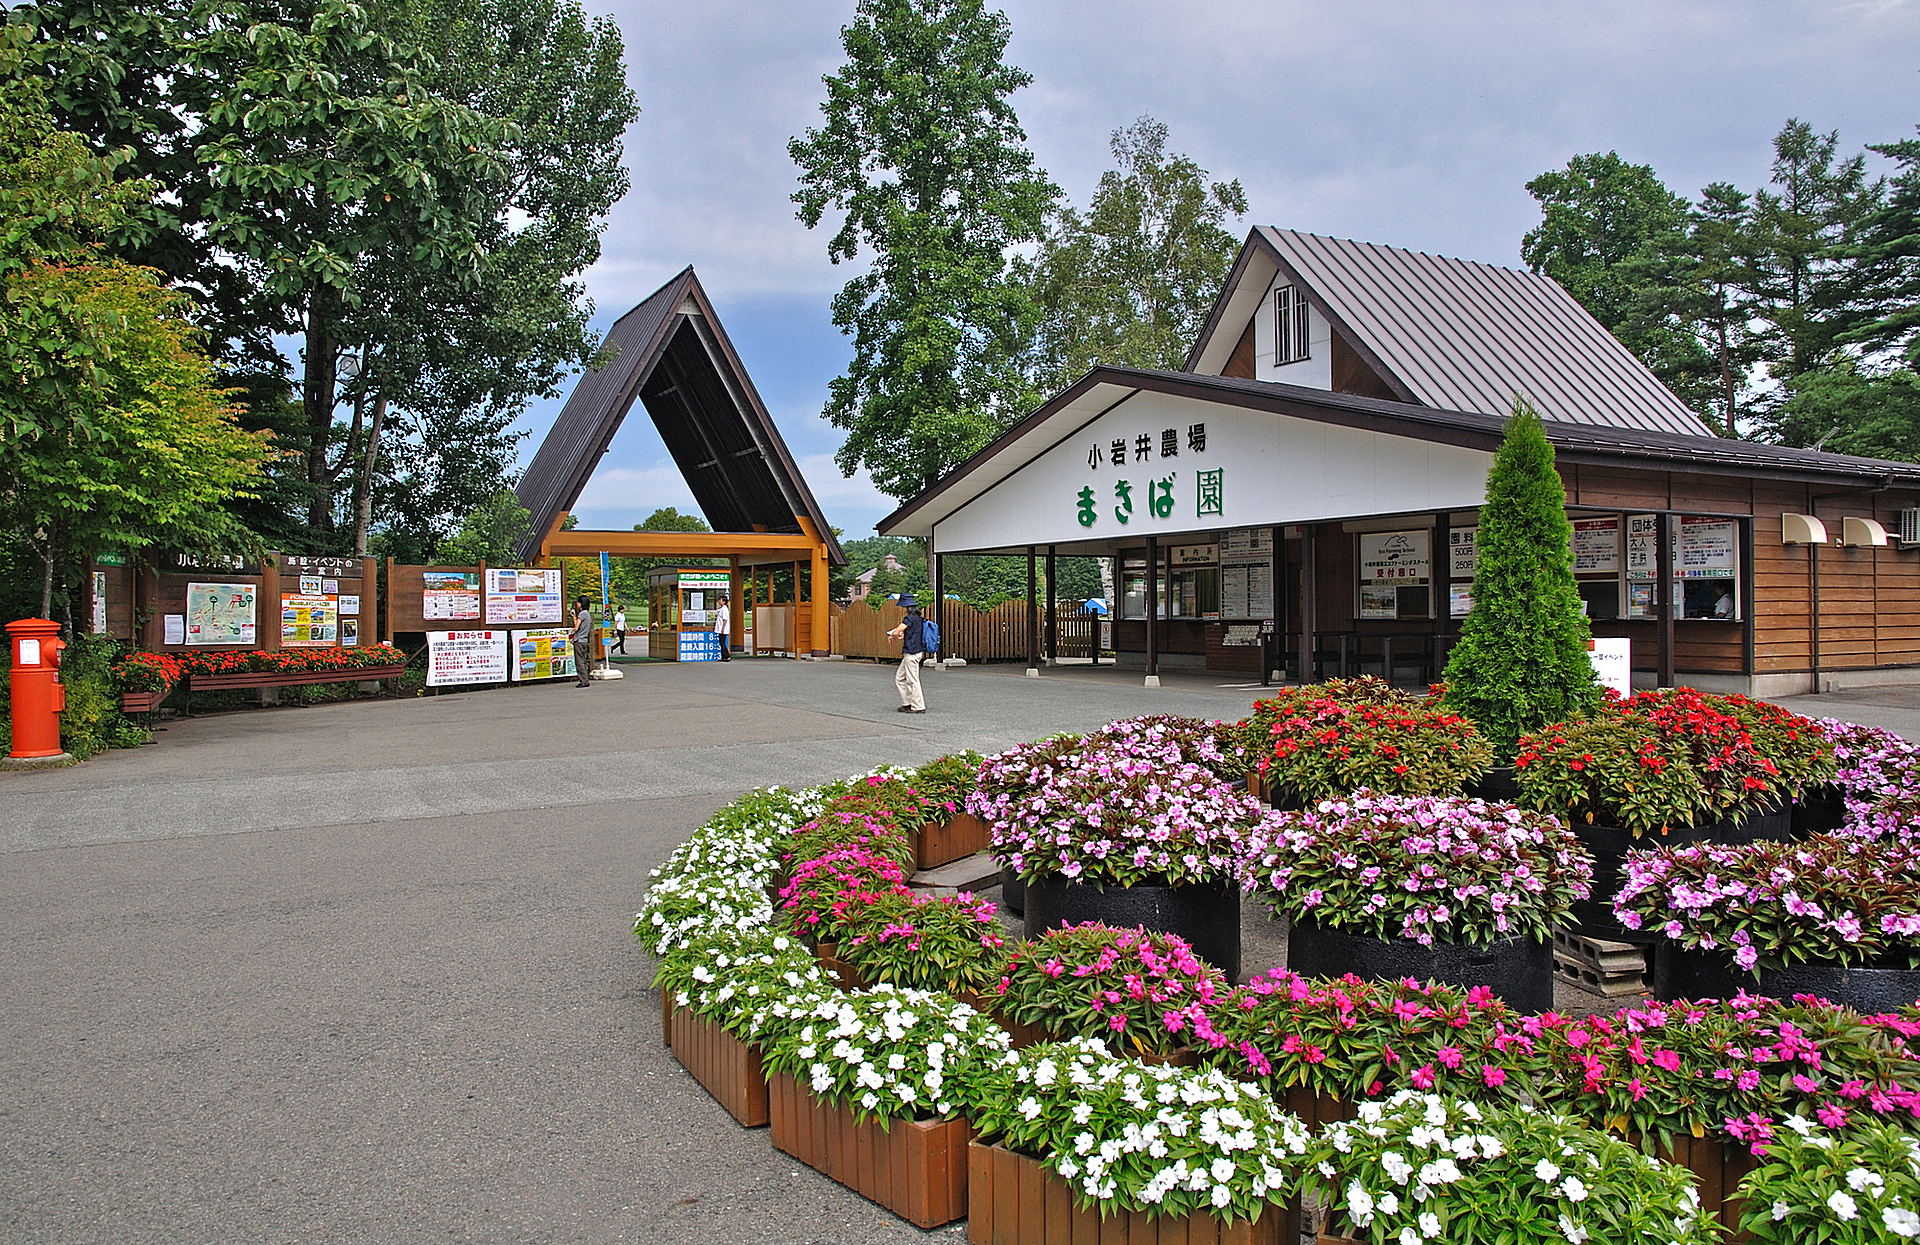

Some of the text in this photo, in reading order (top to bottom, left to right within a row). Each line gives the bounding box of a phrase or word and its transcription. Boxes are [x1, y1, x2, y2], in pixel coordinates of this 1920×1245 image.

[1087, 423, 1207, 470] 小岩井農場
[1076, 467, 1224, 528] まきば園
[1629, 537, 1647, 548] 大人
[1179, 548, 1213, 557] 案内所
[1454, 547, 1473, 556] 500円
[1630, 553, 1647, 562] 子供
[1455, 560, 1474, 570] 250円
[1376, 568, 1417, 578] 受付窓口
[680, 643, 705, 652] 最終入園
